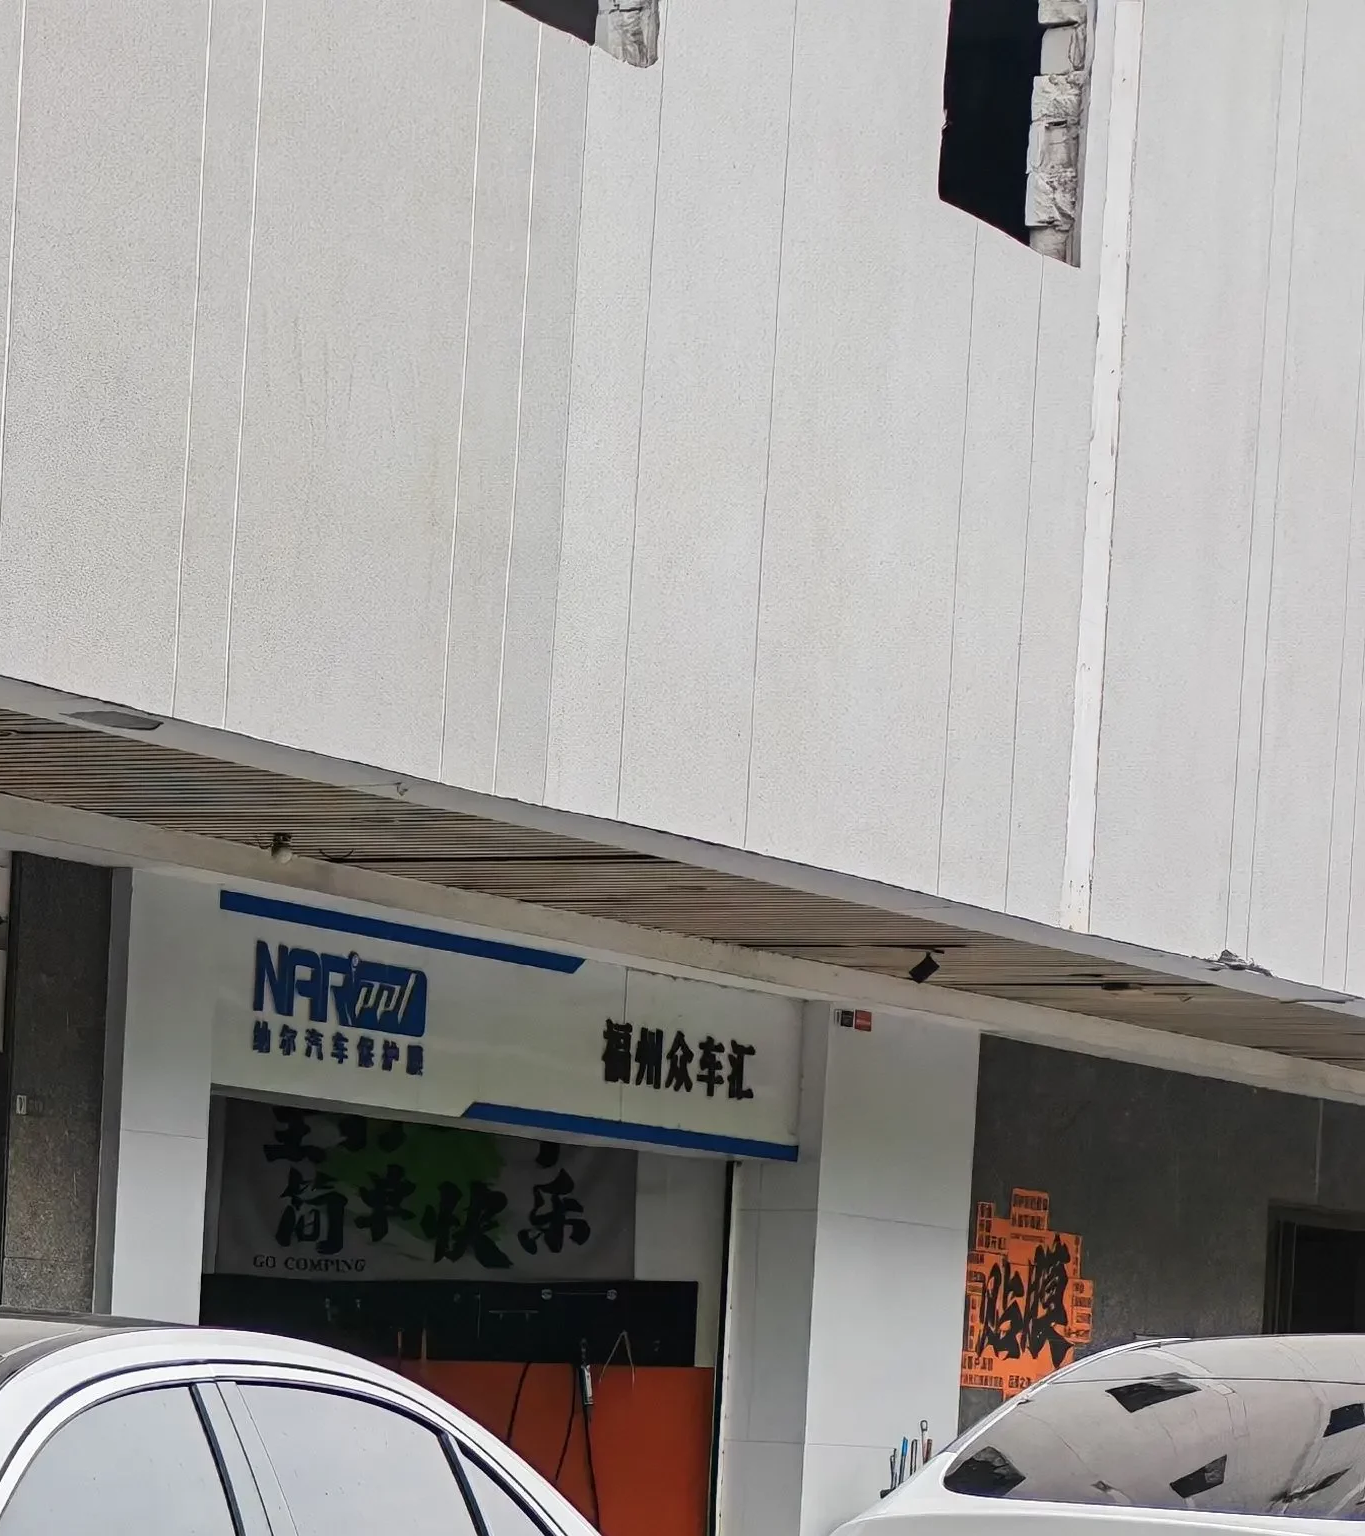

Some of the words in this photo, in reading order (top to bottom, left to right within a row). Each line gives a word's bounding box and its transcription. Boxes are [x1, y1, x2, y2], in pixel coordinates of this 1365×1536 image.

[601, 1018, 757, 1101] 福州众车汇
